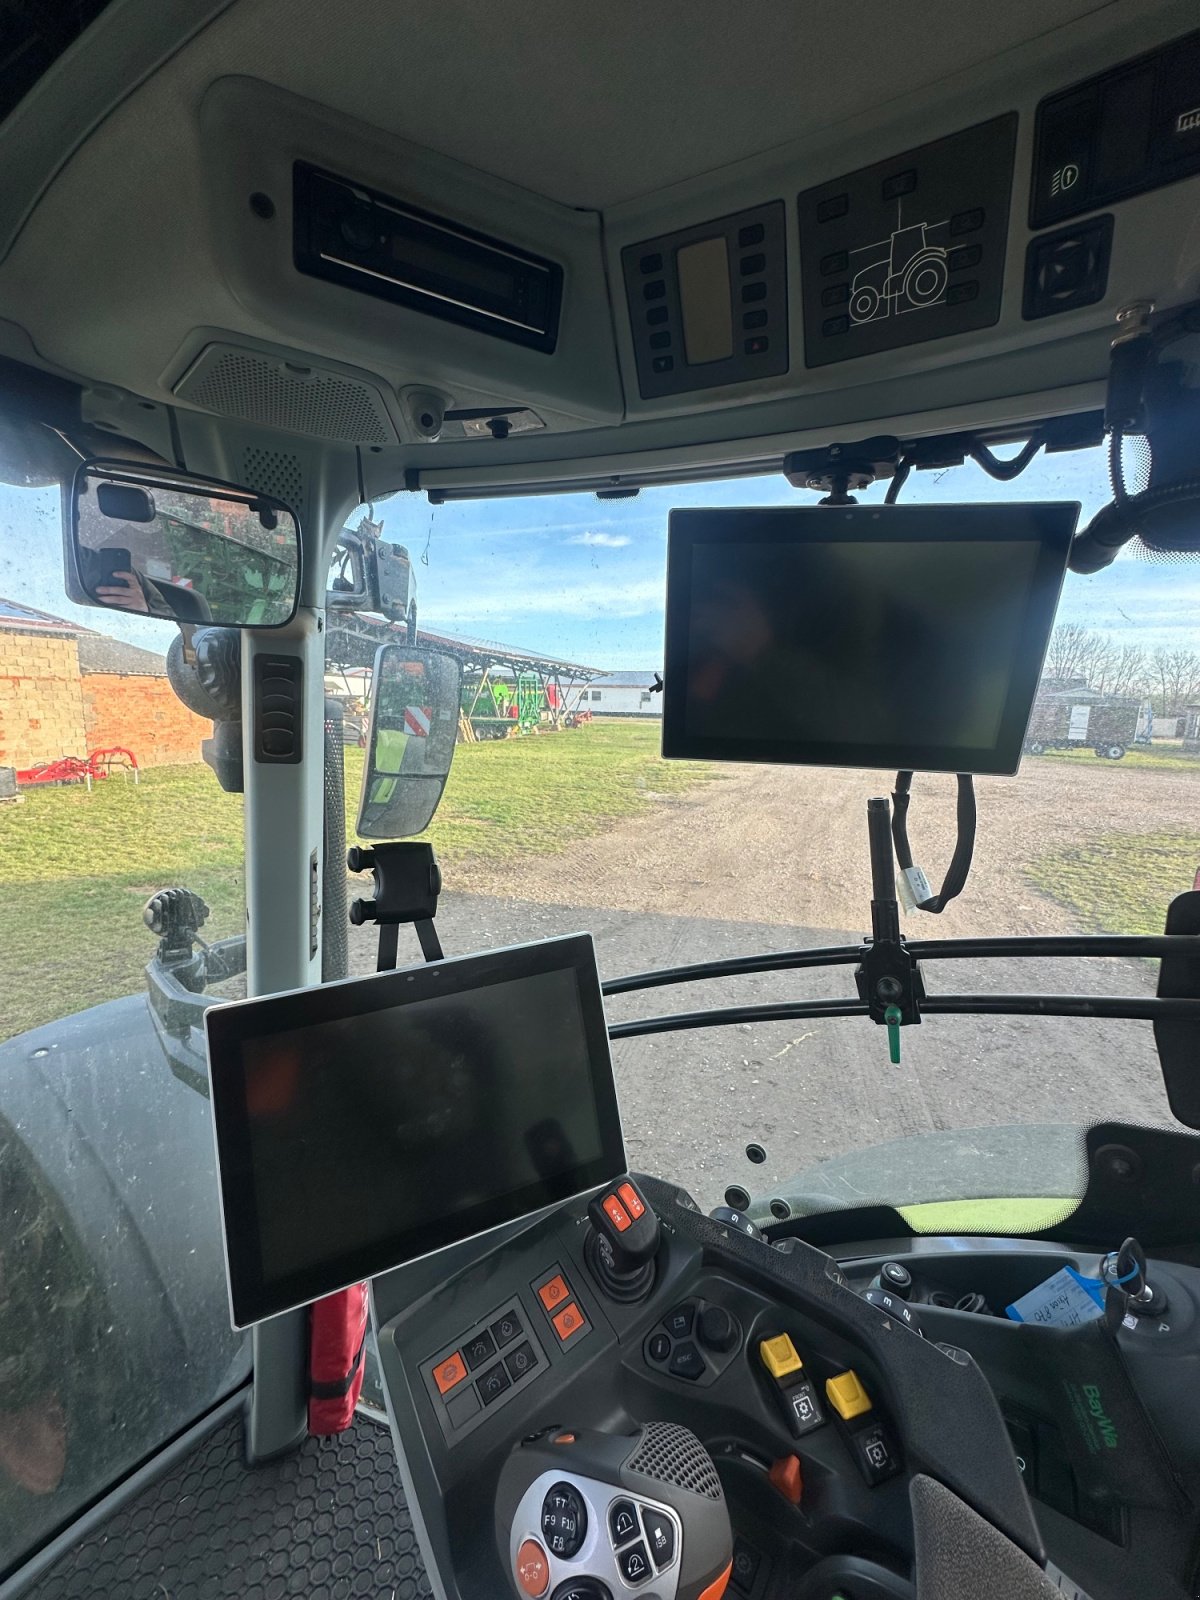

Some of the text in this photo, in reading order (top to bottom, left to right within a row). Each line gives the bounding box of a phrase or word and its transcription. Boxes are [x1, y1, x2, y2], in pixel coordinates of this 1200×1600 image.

[883, 1296, 892, 1307] 3
[903, 1308, 911, 1321] 2
[1158, 1322, 1170, 1333] P
[792, 1391, 806, 1400] FRONT
[1083, 1385, 1118, 1448] BayWa
[555, 1498, 567, 1508] F7
[544, 1515, 575, 1531] F9 F10
[620, 1517, 628, 1528] 1
[552, 1535, 564, 1550] F8
[655, 1536, 667, 1549] ISB
[631, 1557, 640, 1571] 2
